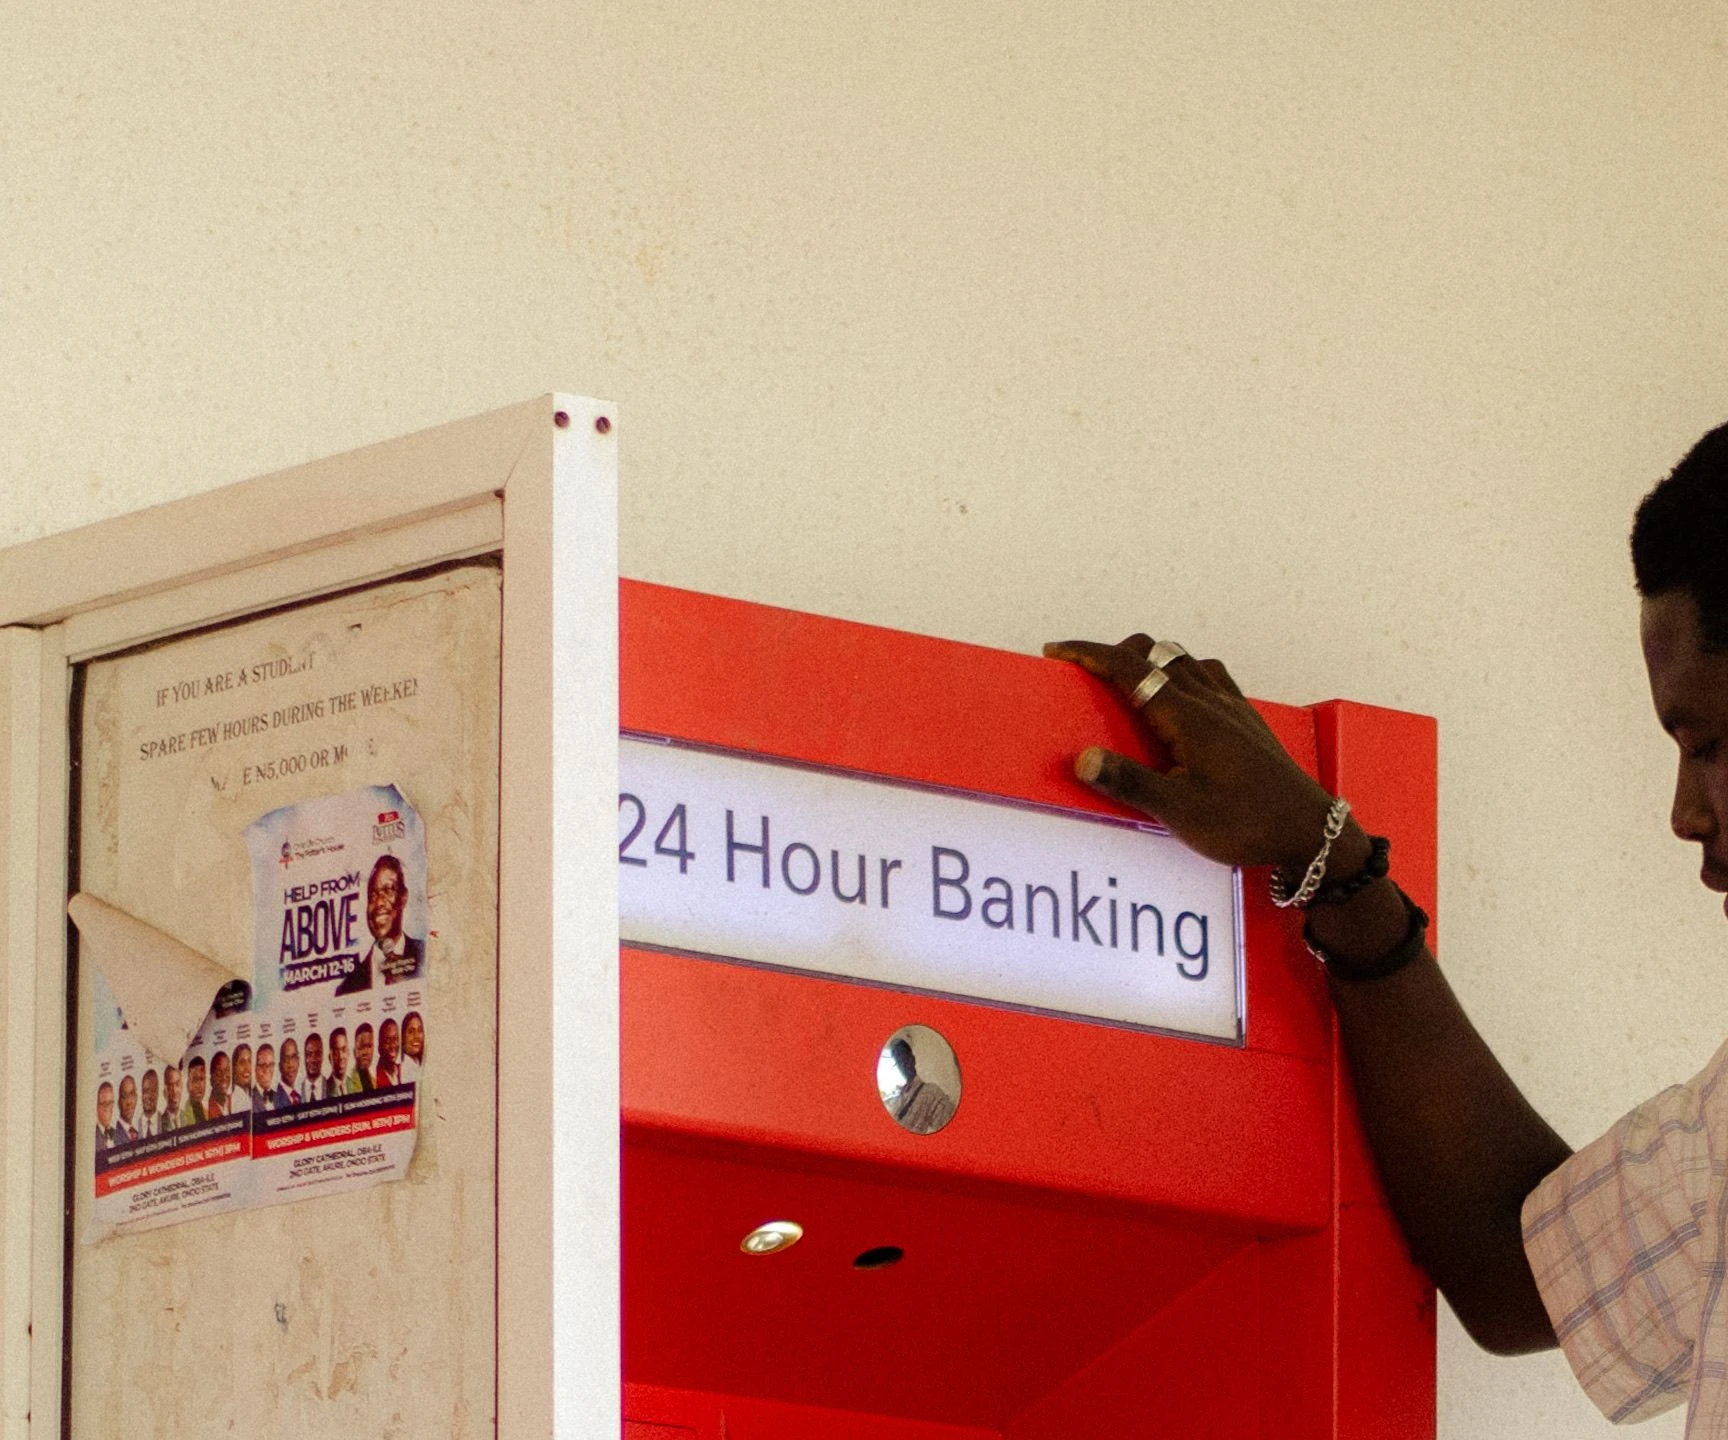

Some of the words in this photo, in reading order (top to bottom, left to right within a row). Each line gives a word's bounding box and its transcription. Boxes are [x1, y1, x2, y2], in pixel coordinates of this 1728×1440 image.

[156, 688, 169, 709] IF
[172, 680, 200, 703] YOU
[204, 671, 234, 695] ARE
[237, 667, 248, 688] A
[140, 733, 186, 761] SPARE
[190, 721, 221, 749] FEW
[223, 713, 269, 741] HOURS
[273, 700, 324, 728] DURING
[328, 691, 357, 715] THE
[310, 749, 329, 769] OR
[284, 883, 318, 905] HELP
[320, 871, 360, 897] FROM
[618, 792, 696, 875] 24
[725, 808, 902, 909] Hour
[931, 845, 1209, 982] Banking
[279, 892, 359, 965] ABOVE
[284, 964, 327, 984] MARCH
